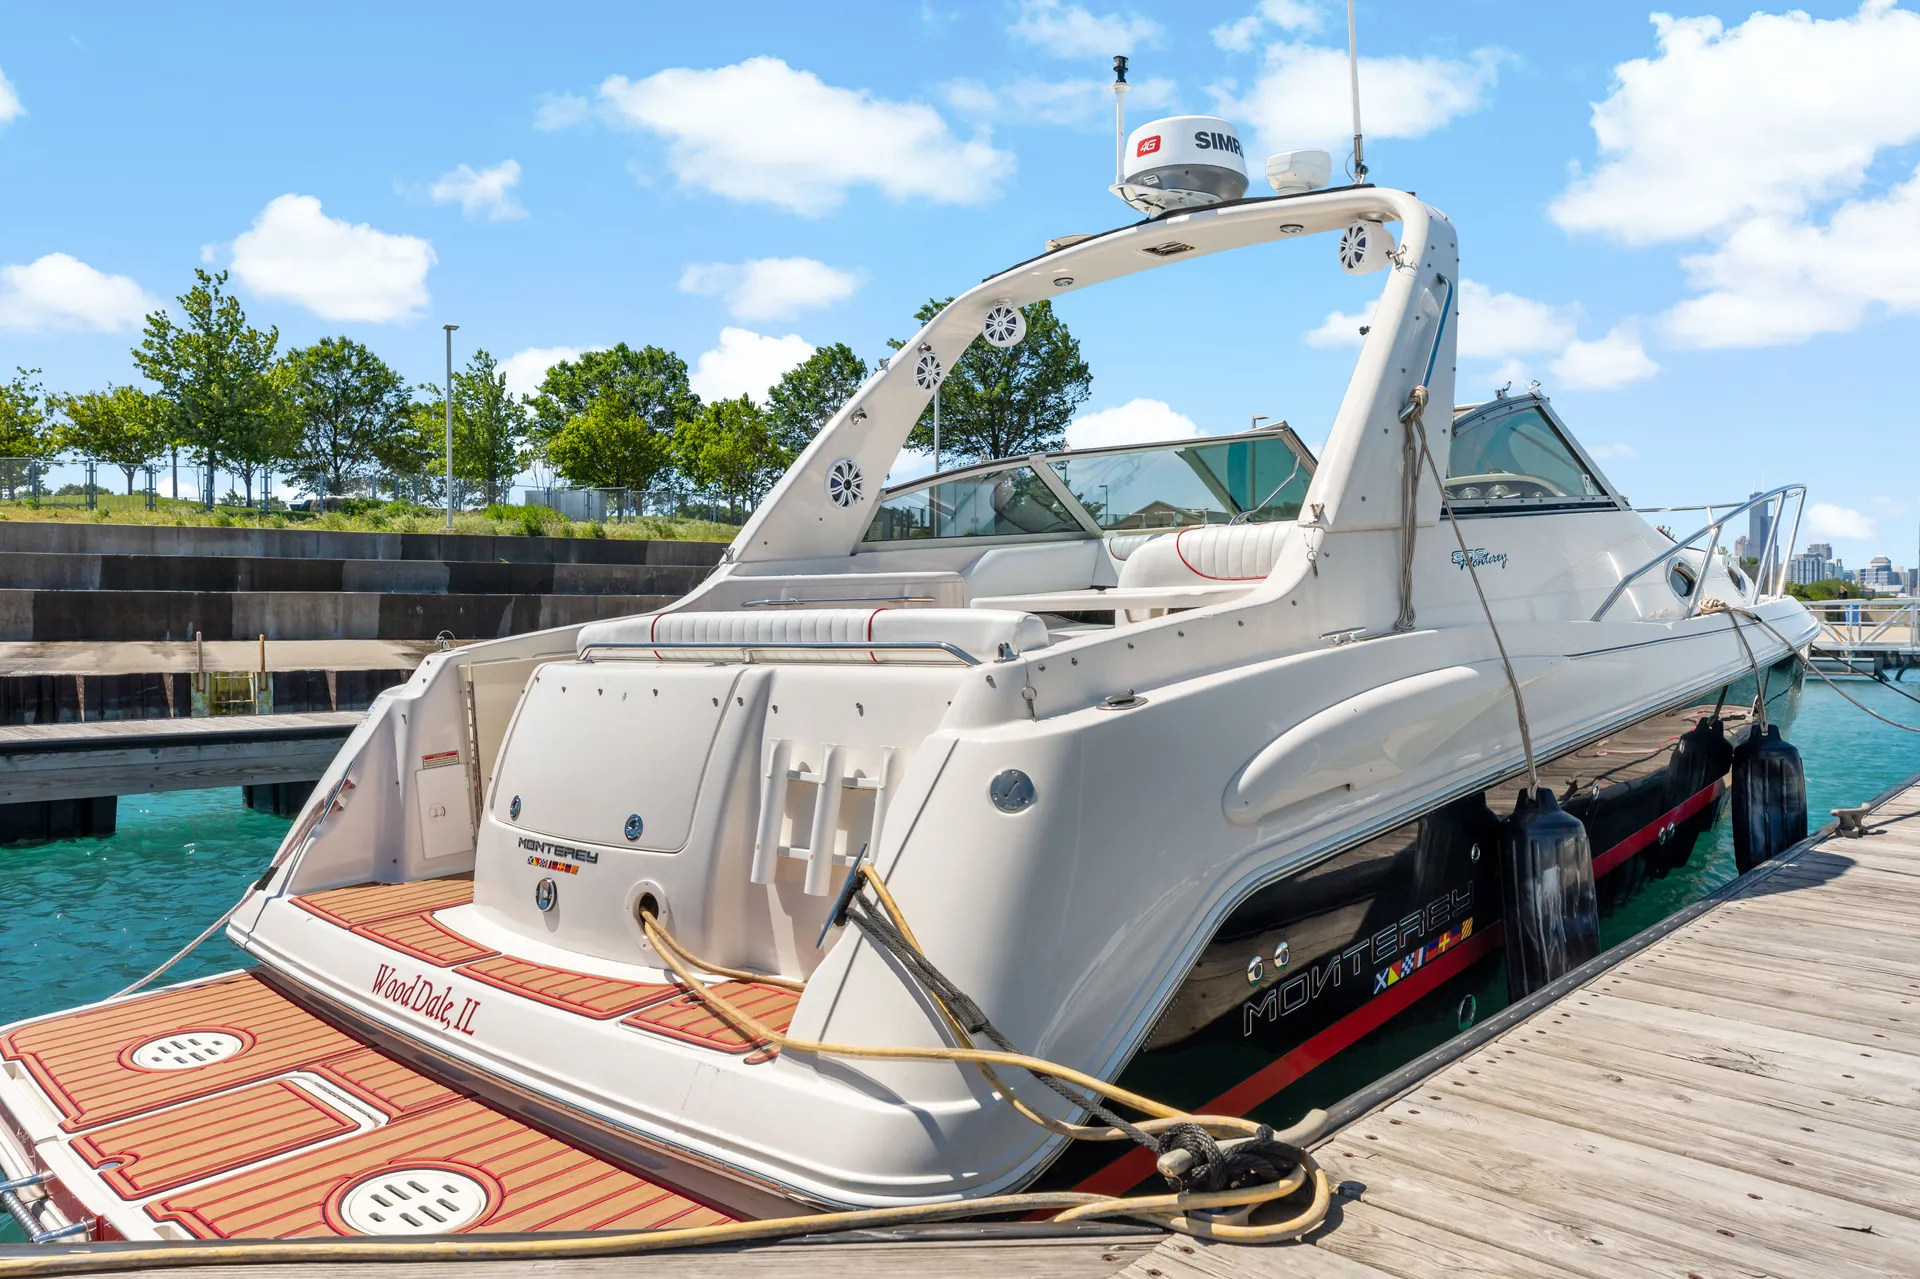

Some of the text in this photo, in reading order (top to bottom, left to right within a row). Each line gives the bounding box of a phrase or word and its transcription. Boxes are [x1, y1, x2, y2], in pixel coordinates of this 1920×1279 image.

[1140, 139, 1157, 152] 4G
[518, 837, 599, 864] MONTEREY
[1243, 880, 1475, 1037] MONTEREY
[453, 997, 481, 1036] IL
